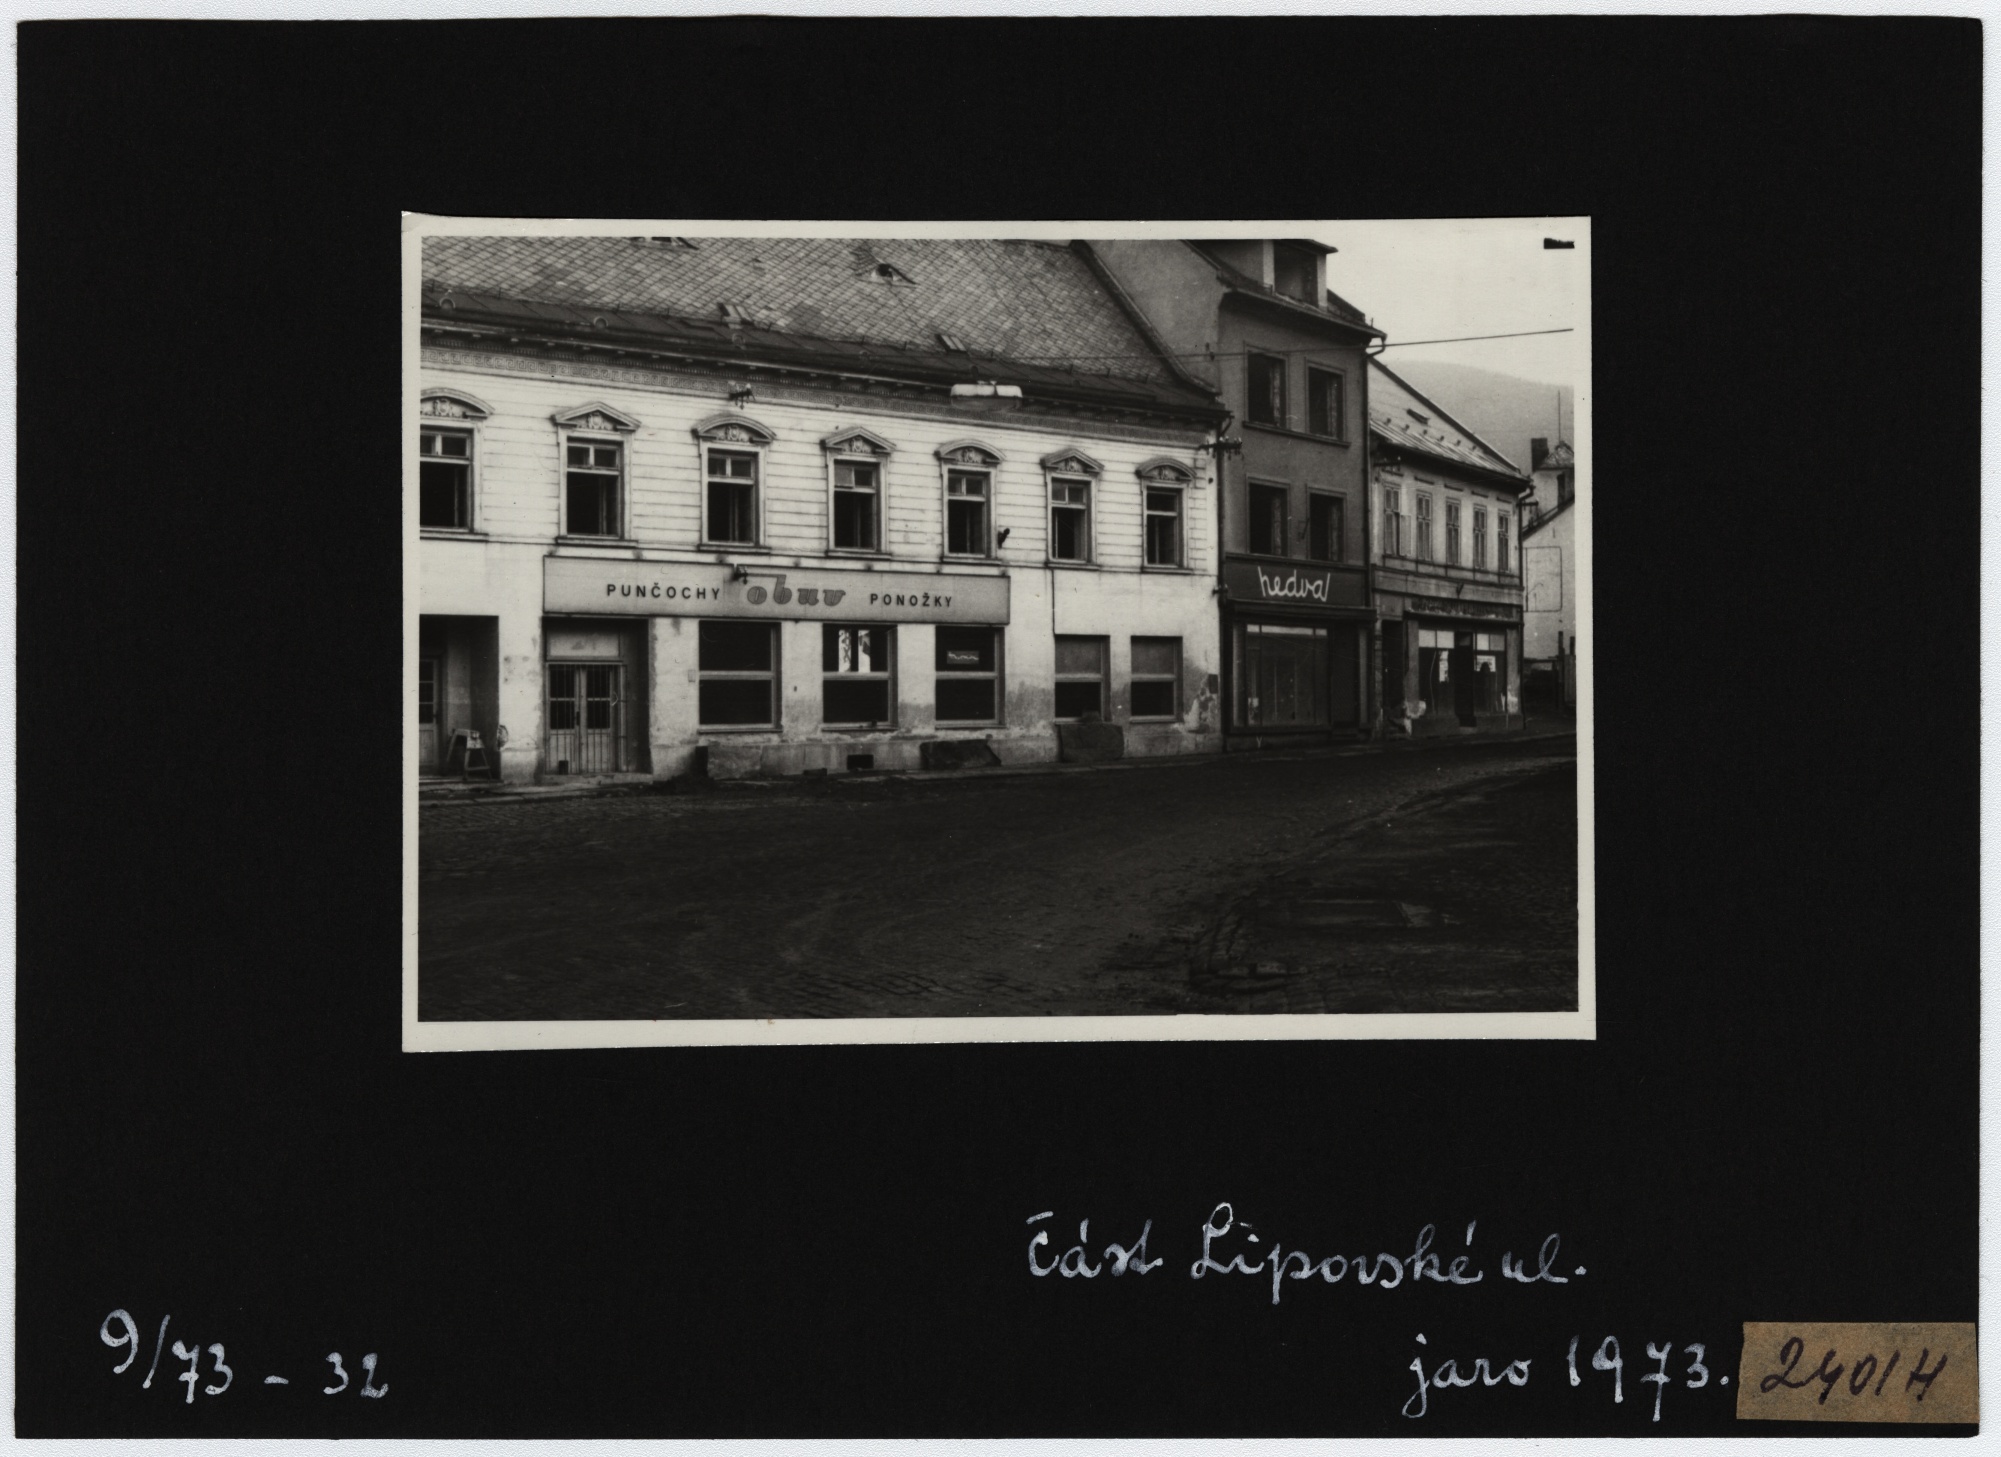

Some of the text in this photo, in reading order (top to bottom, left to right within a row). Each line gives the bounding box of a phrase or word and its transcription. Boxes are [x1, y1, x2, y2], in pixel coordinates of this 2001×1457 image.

[606, 582, 721, 601] PUNČOCHY
[746, 573, 846, 606] obuv
[869, 592, 953, 608] PONOŽKY
[1501, 1233, 1587, 1284] ul.
[100, 1308, 234, 1404] 9/73
[323, 1351, 389, 1399] 32
[1401, 1332, 1730, 1422] jaro 1973.
